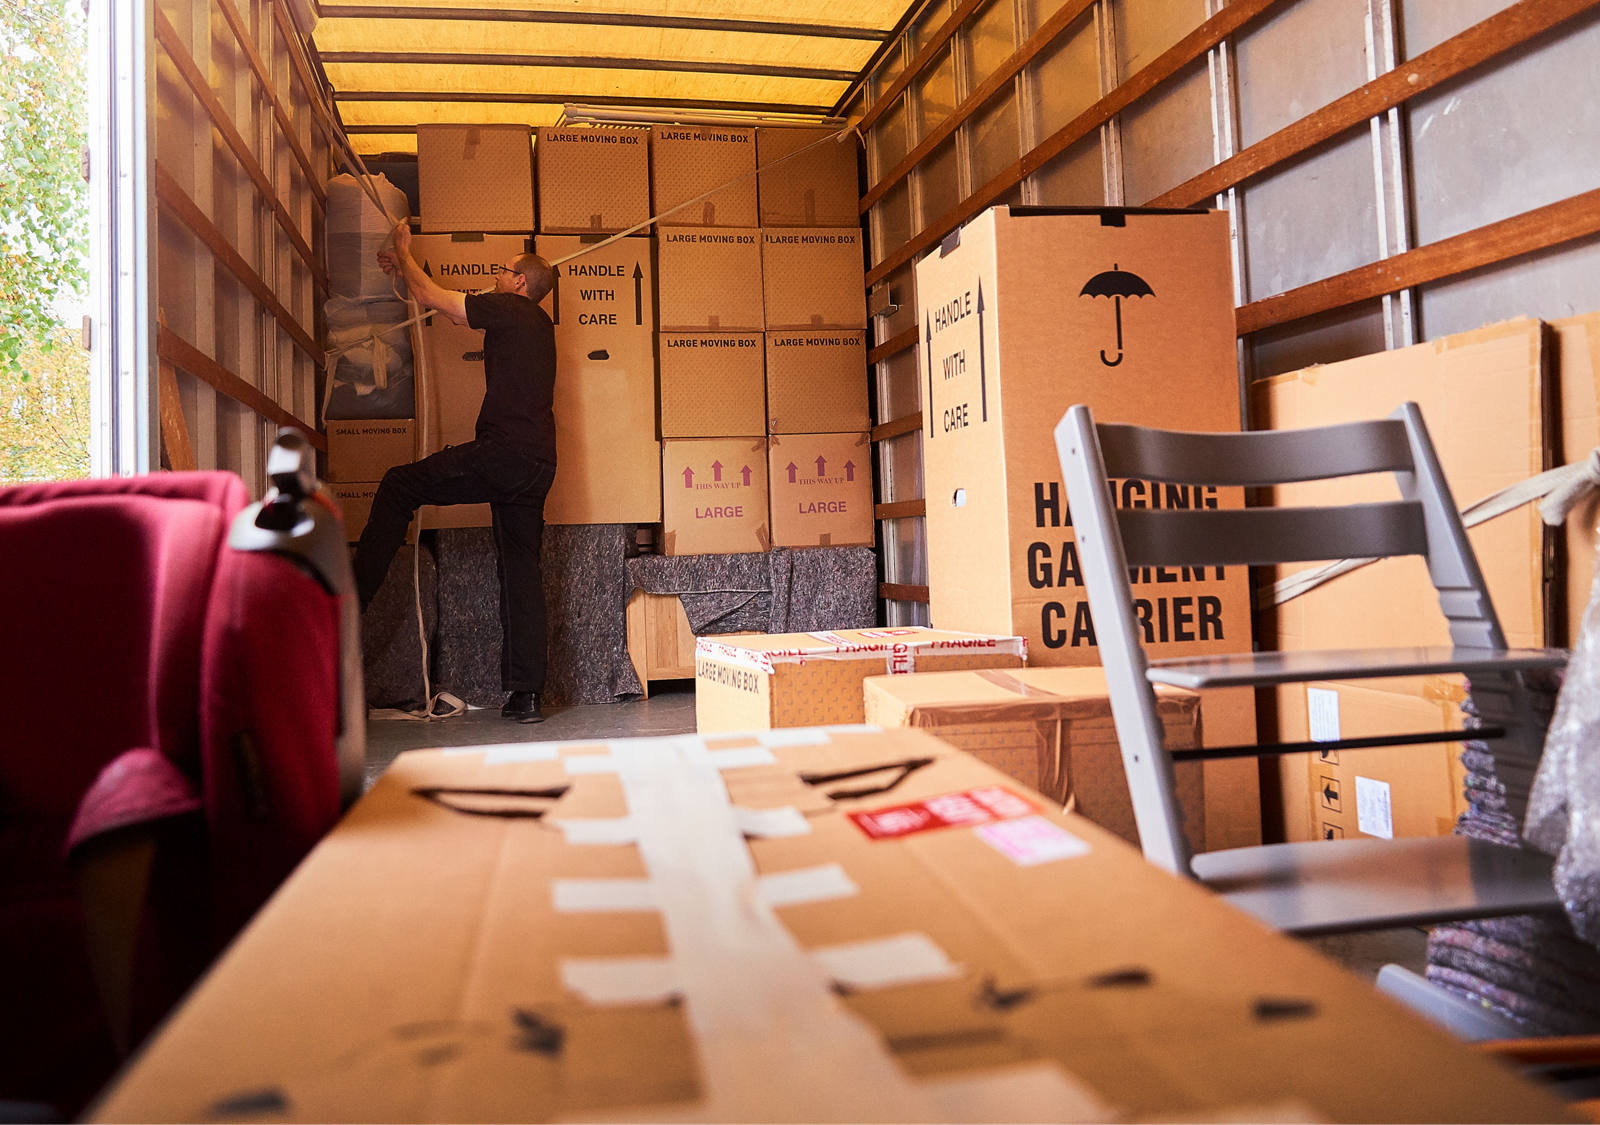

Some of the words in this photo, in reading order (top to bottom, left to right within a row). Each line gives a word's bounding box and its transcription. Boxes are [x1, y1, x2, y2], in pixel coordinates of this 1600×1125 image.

[547, 132, 578, 143] LARGE
[580, 134, 618, 144] MOVING
[620, 136, 638, 145] BOX
[661, 132, 691, 141] LARGE
[730, 134, 748, 143] BOX
[666, 234, 696, 242] LARGE
[802, 236, 835, 244] MOVING
[440, 264, 498, 276] HANDLE
[568, 265, 625, 277] HANDLE
[580, 289, 615, 301] WITH
[935, 290, 972, 332] HANDLE
[578, 314, 617, 326] CARE
[806, 338, 840, 346] MOVING
[942, 349, 966, 380] WITH
[943, 403, 969, 433] CARE
[799, 501, 847, 514] LARGE
[1034, 479, 1218, 528] HGING
[696, 506, 743, 519] LARGE
[1042, 596, 1224, 649] CARIER
[698, 660, 716, 682] LARGE
[717, 665, 741, 689] MOVING
[744, 672, 759, 694] BOX
